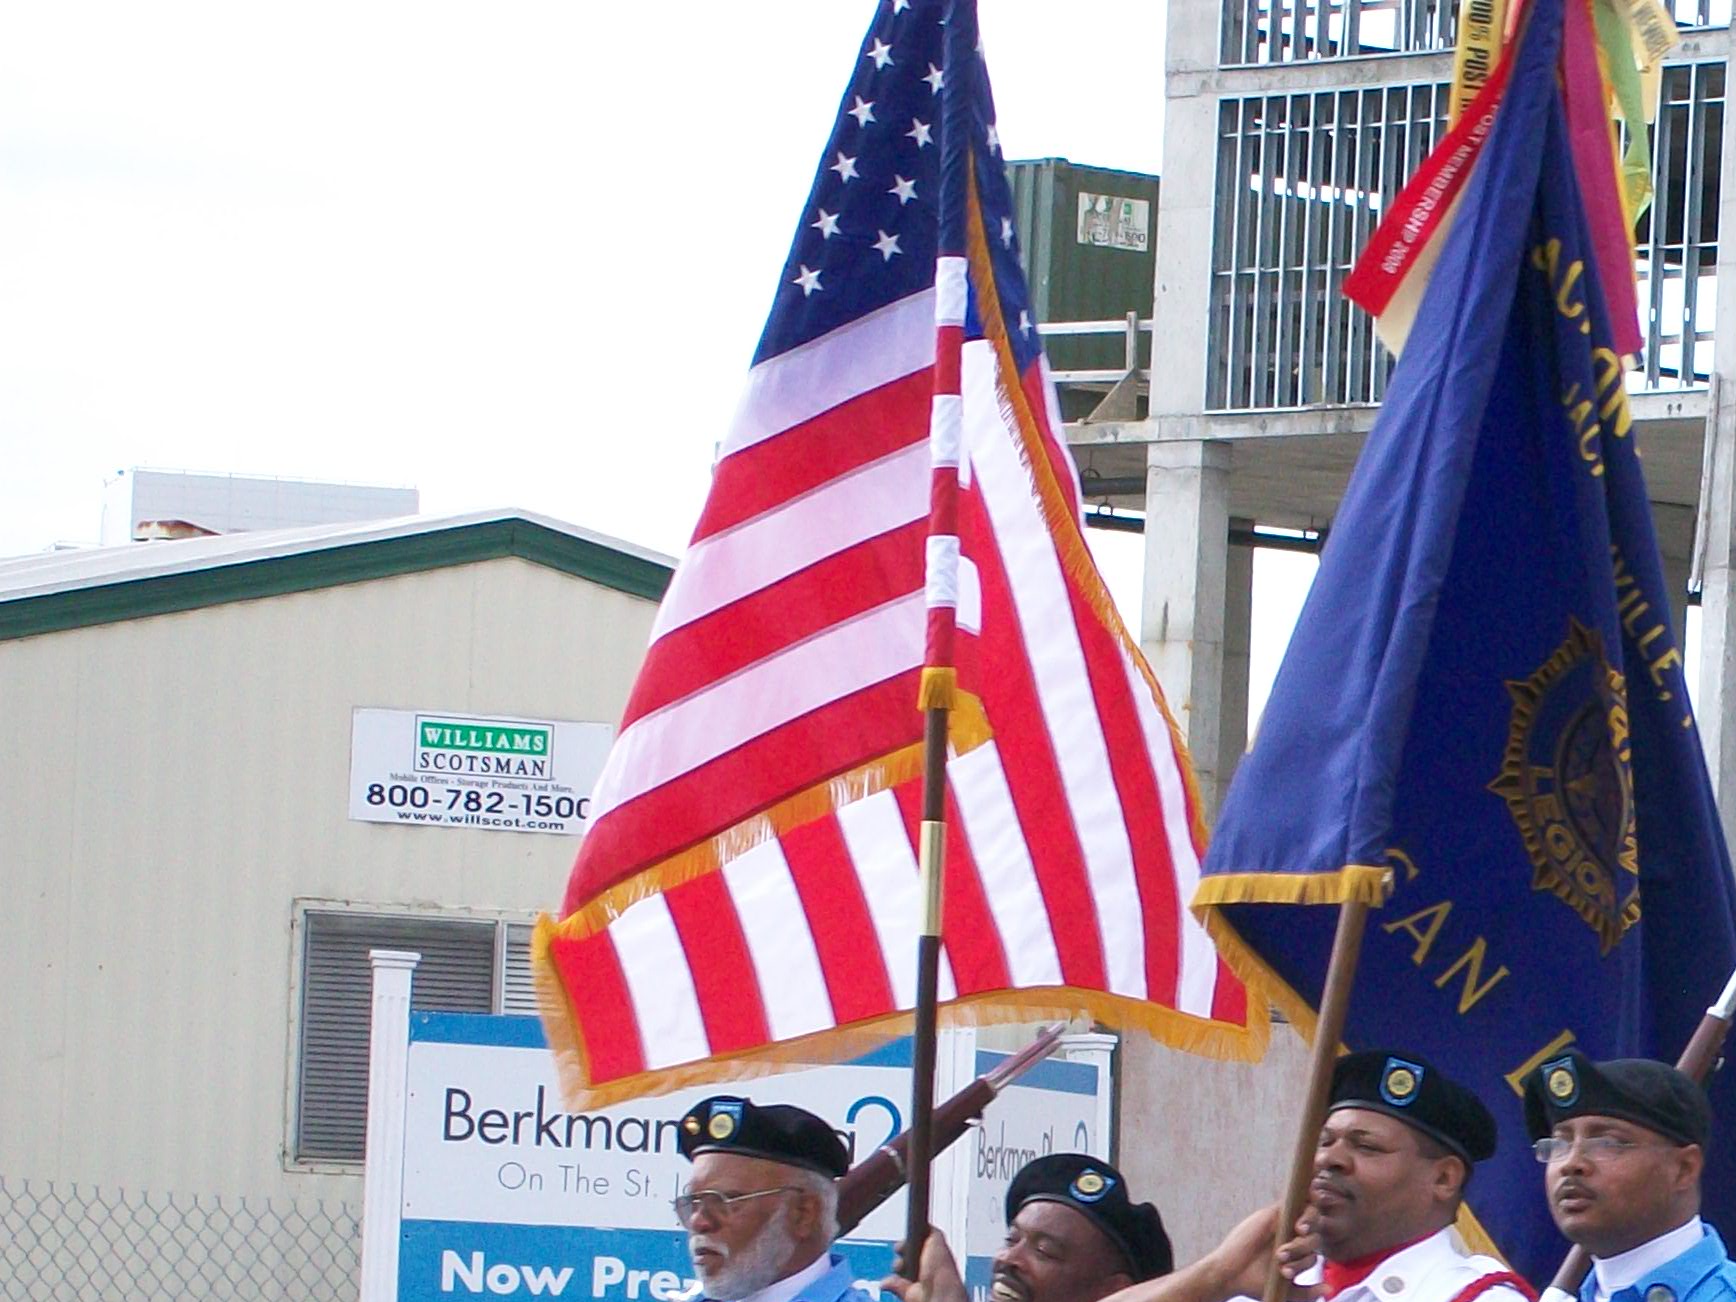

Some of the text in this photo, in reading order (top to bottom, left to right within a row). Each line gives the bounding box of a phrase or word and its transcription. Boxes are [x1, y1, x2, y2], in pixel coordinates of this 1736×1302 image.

[424, 726, 545, 751] WILLIAMS
[420, 752, 546, 777] SCOTSMAN
[397, 810, 565, 831] www.willscot.com
[498, 1161, 543, 1191] On
[559, 1165, 610, 1195] The
[624, 1169, 658, 1199] St.
[441, 1250, 574, 1297] Now
